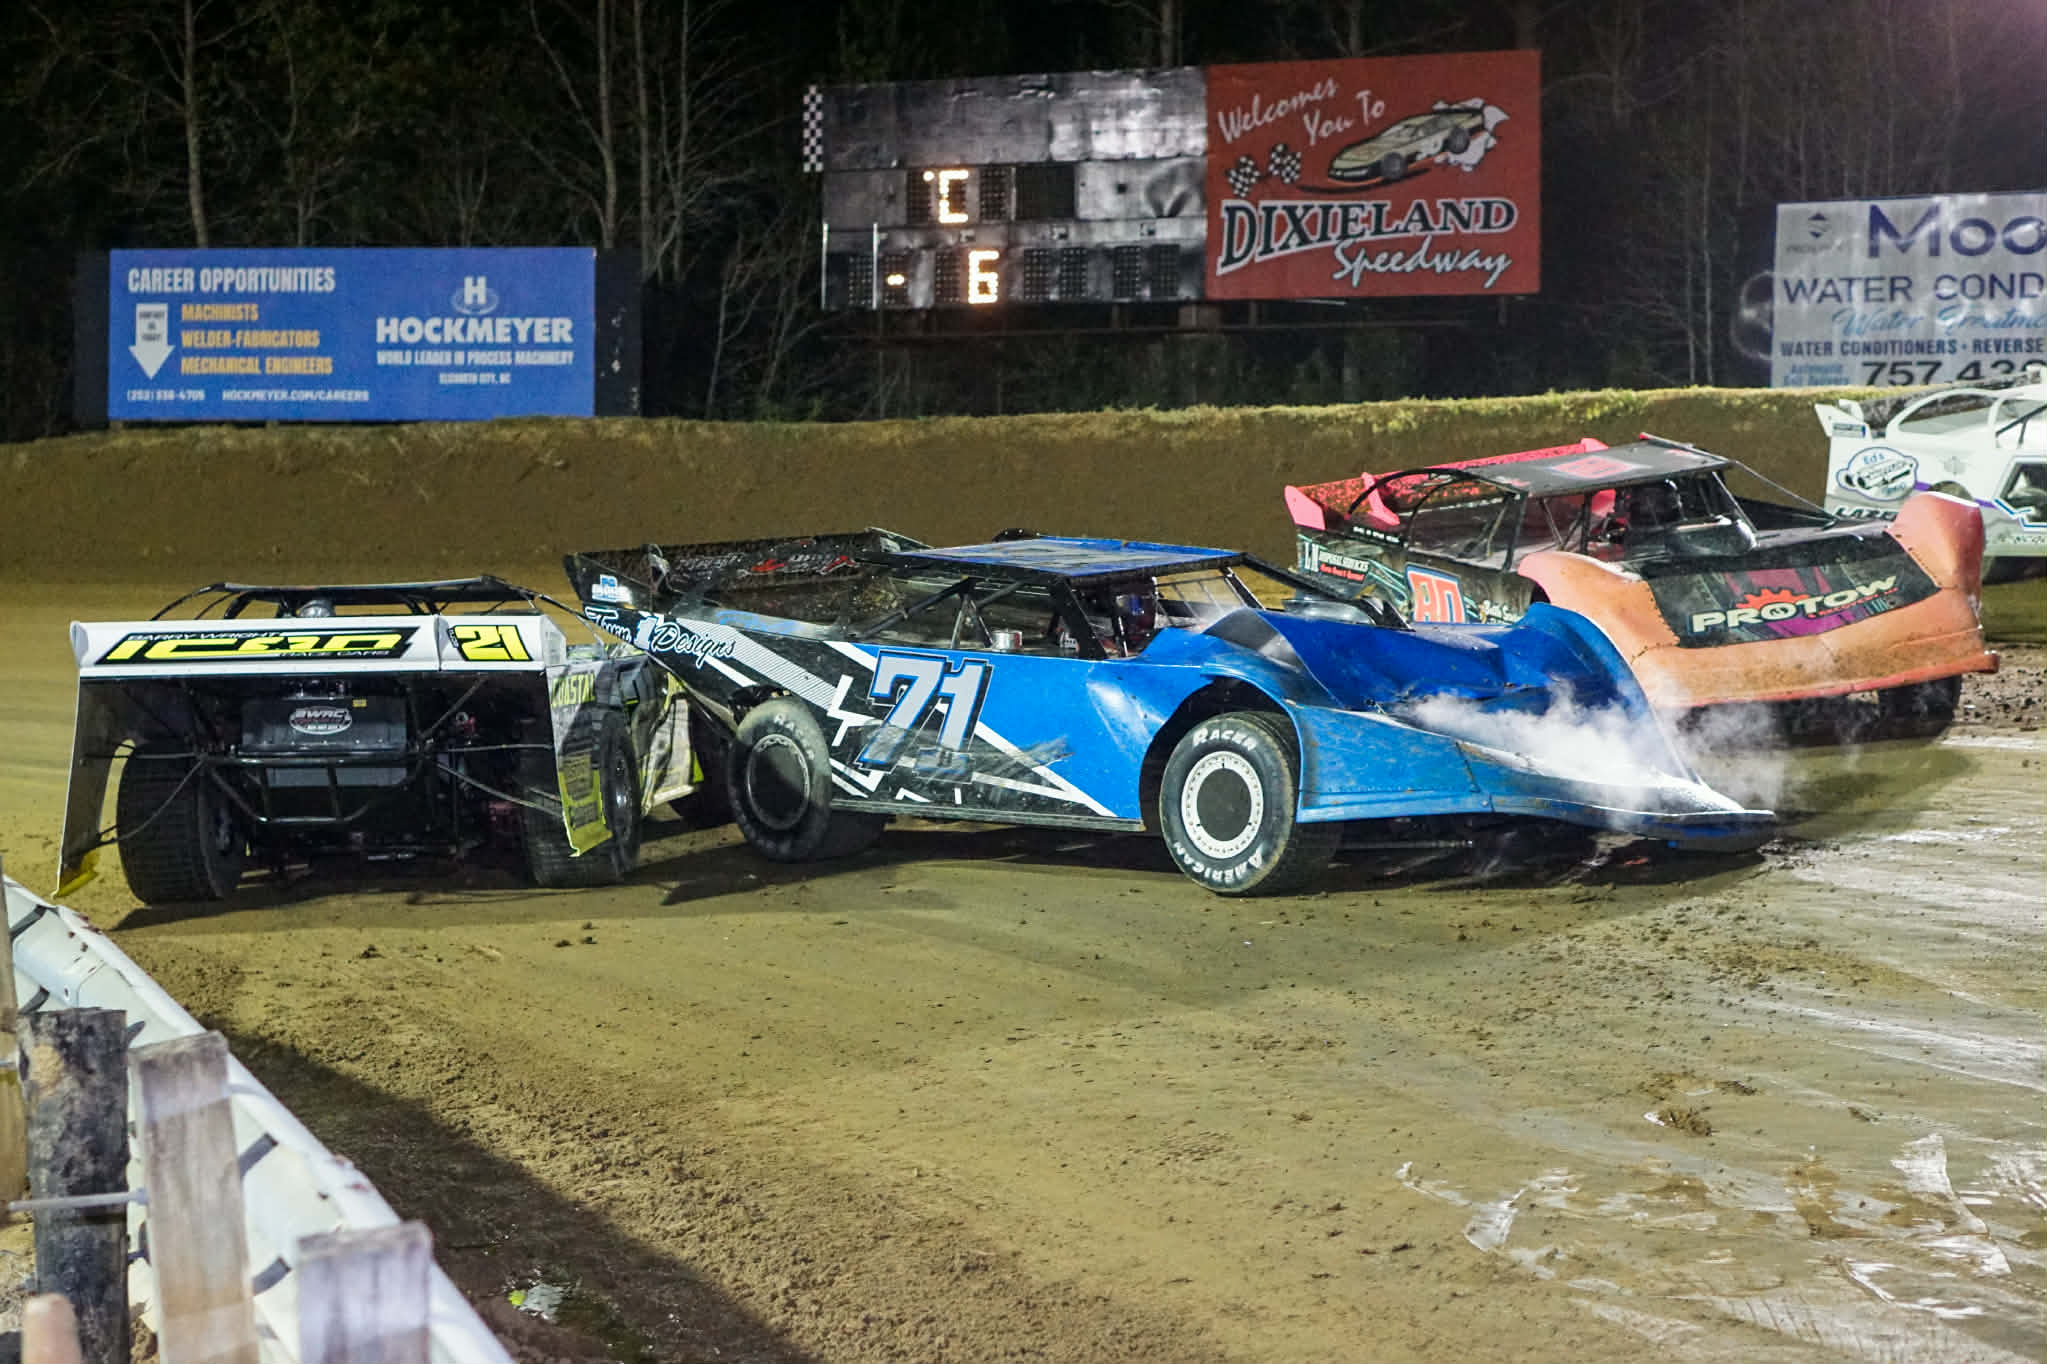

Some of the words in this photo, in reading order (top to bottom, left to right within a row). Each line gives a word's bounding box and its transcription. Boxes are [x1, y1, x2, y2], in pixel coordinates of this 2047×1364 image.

[1217, 78, 1339, 144] Welcomes
[1303, 110, 1353, 146] You
[1355, 90, 1386, 126] To
[1216, 198, 1517, 276] DIXIELAND
[968, 250, 999, 304] 6
[1333, 235, 1512, 288] Speedway
[128, 267, 195, 293] CAREER
[200, 267, 336, 292] OPPORTUNITIES
[464, 276, 487, 305] H
[1783, 276, 1913, 304] WATER
[1935, 272, 2044, 300] COND
[181, 303, 259, 321] MACHINISTS
[181, 329, 320, 348] WELDER-FABRICATORS
[375, 317, 574, 344] HOCKMEYER
[1781, 341, 1832, 356] WATER
[1841, 339, 1957, 355] CONDITIONERS
[1972, 337, 2043, 353] REVERSE
[181, 357, 261, 375] MECHANICAL
[265, 357, 333, 375] ENGINEERS
[222, 389, 370, 401] HOCKMEYER.COM/CAREERS
[454, 625, 532, 661] 21
[651, 622, 736, 669] Designs
[855, 650, 993, 783] 71
[1172, 842, 1264, 883] AMERICAN
